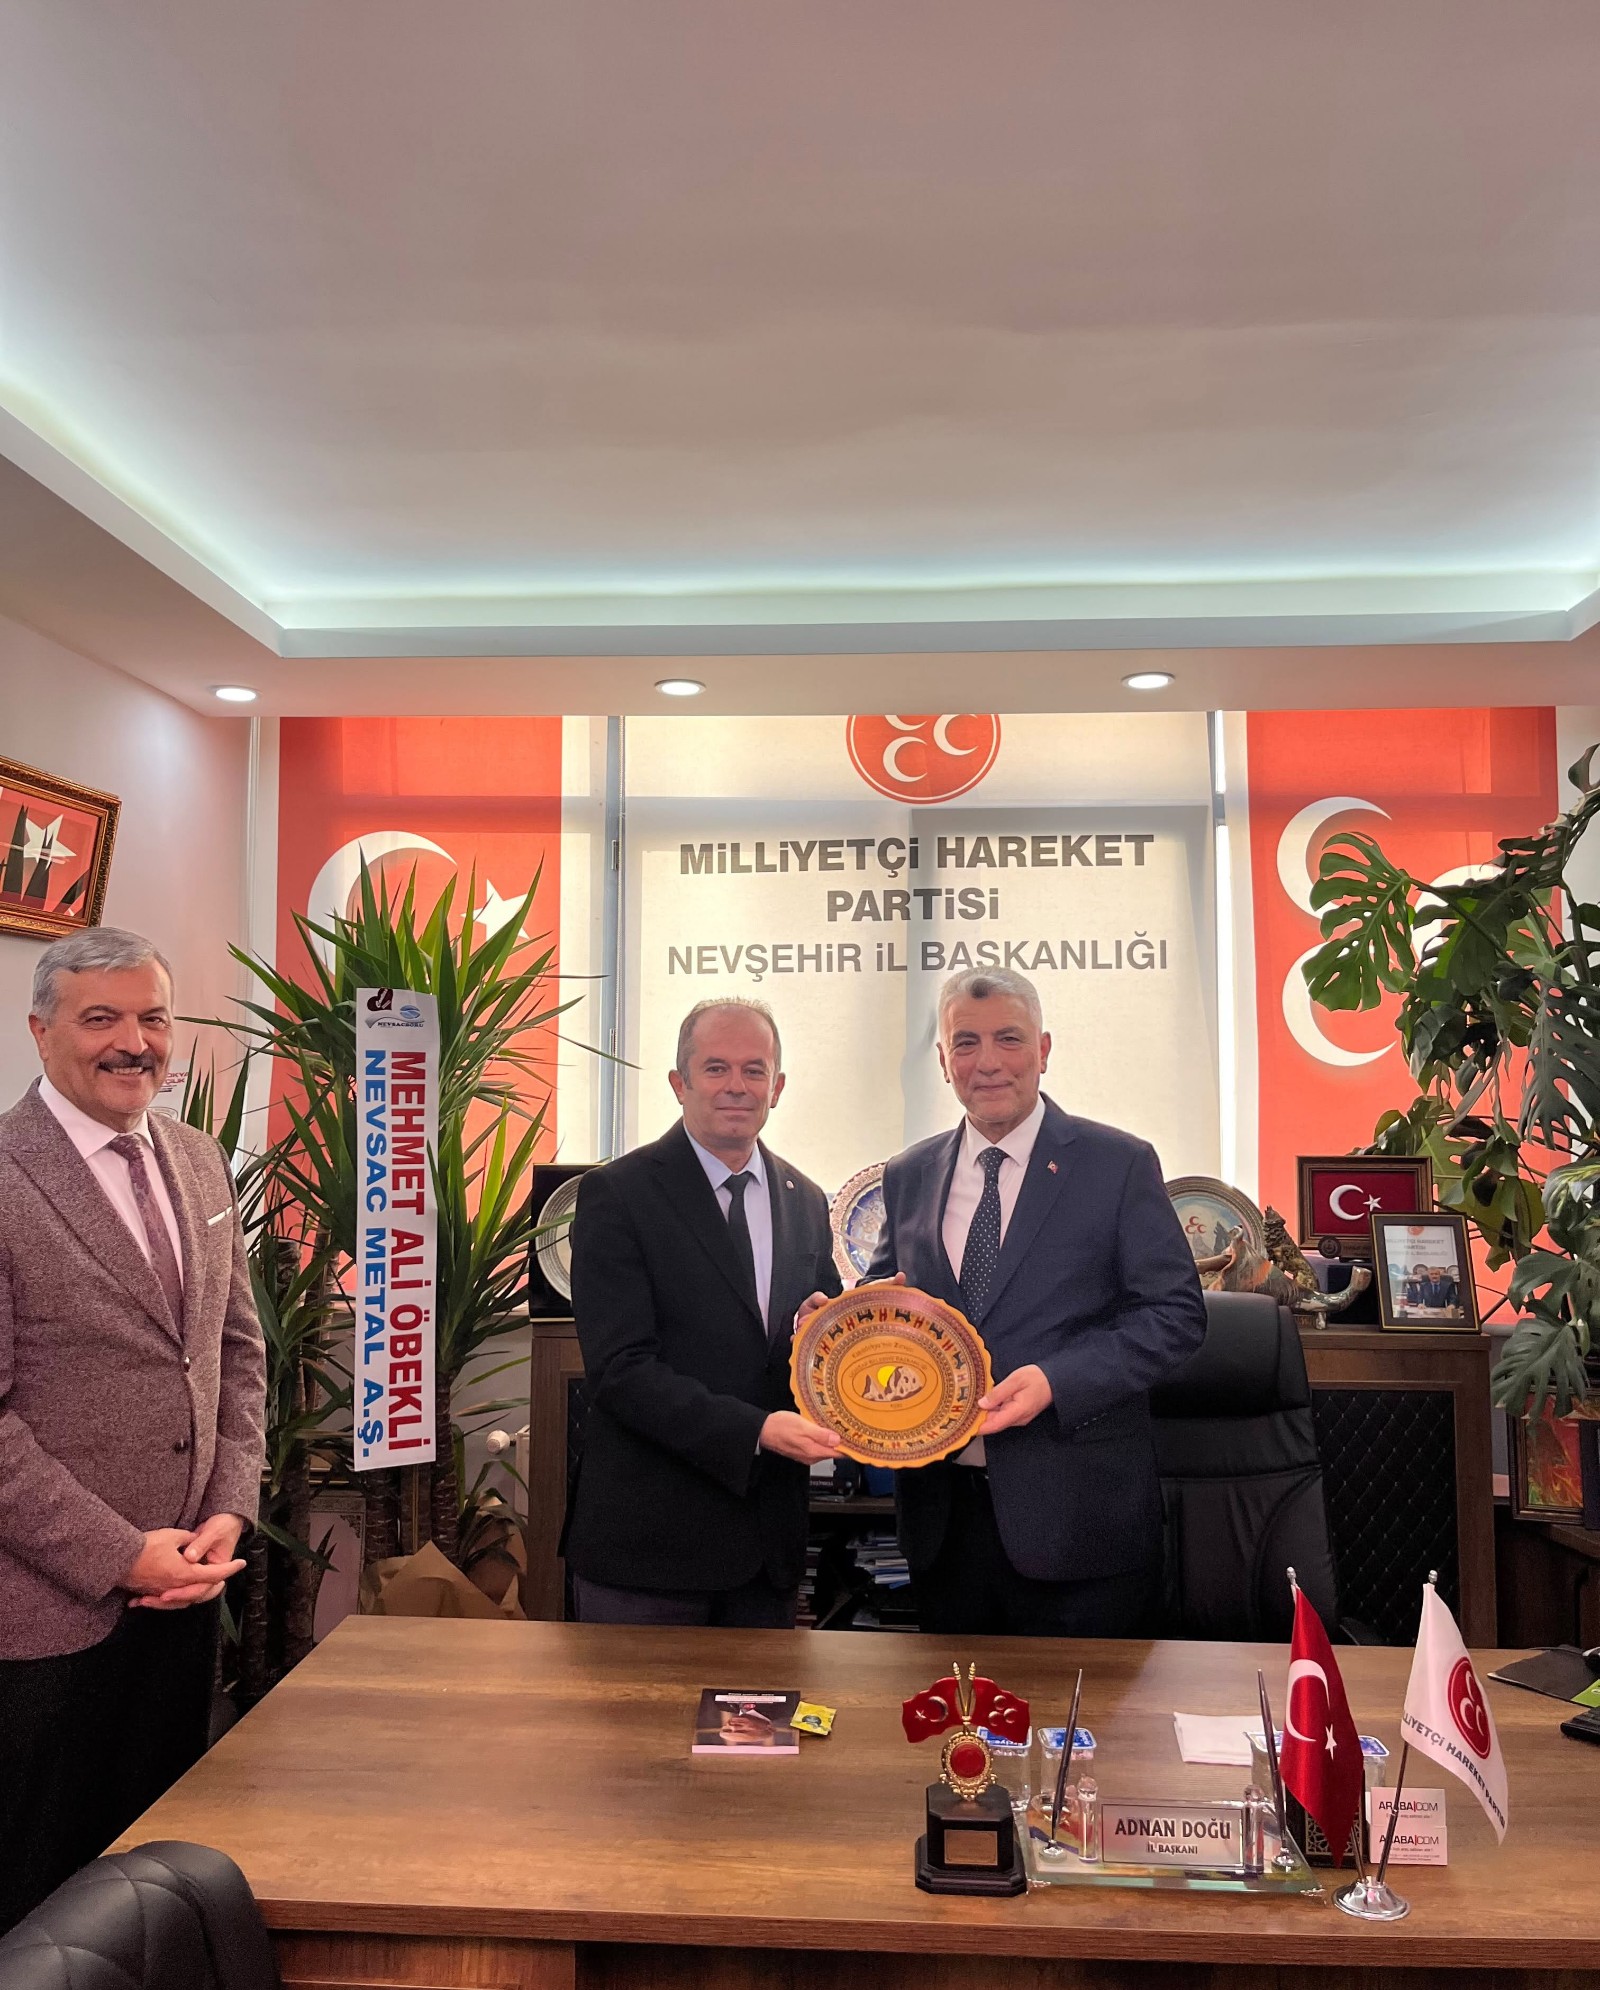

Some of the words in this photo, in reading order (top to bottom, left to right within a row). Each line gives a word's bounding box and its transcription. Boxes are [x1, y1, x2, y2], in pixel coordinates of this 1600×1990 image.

[937, 834, 1155, 868] HAREKET
[365, 1050, 387, 1213] NEVSAC
[391, 1051, 426, 1215] MEHMET
[390, 1228, 432, 1290] ALİ
[364, 1228, 386, 1365] METAL
[389, 1304, 431, 1451] ÖBEKLİ
[357, 1378, 384, 1457] A.Ş.
[1446, 1742, 1486, 1791] HAREKET
[1115, 1818, 1175, 1837] ADNAN
[1182, 1818, 1231, 1839] DOĞU
[1147, 1840, 1156, 1853] İL
[1158, 1843, 1198, 1855] BAŞKANI
